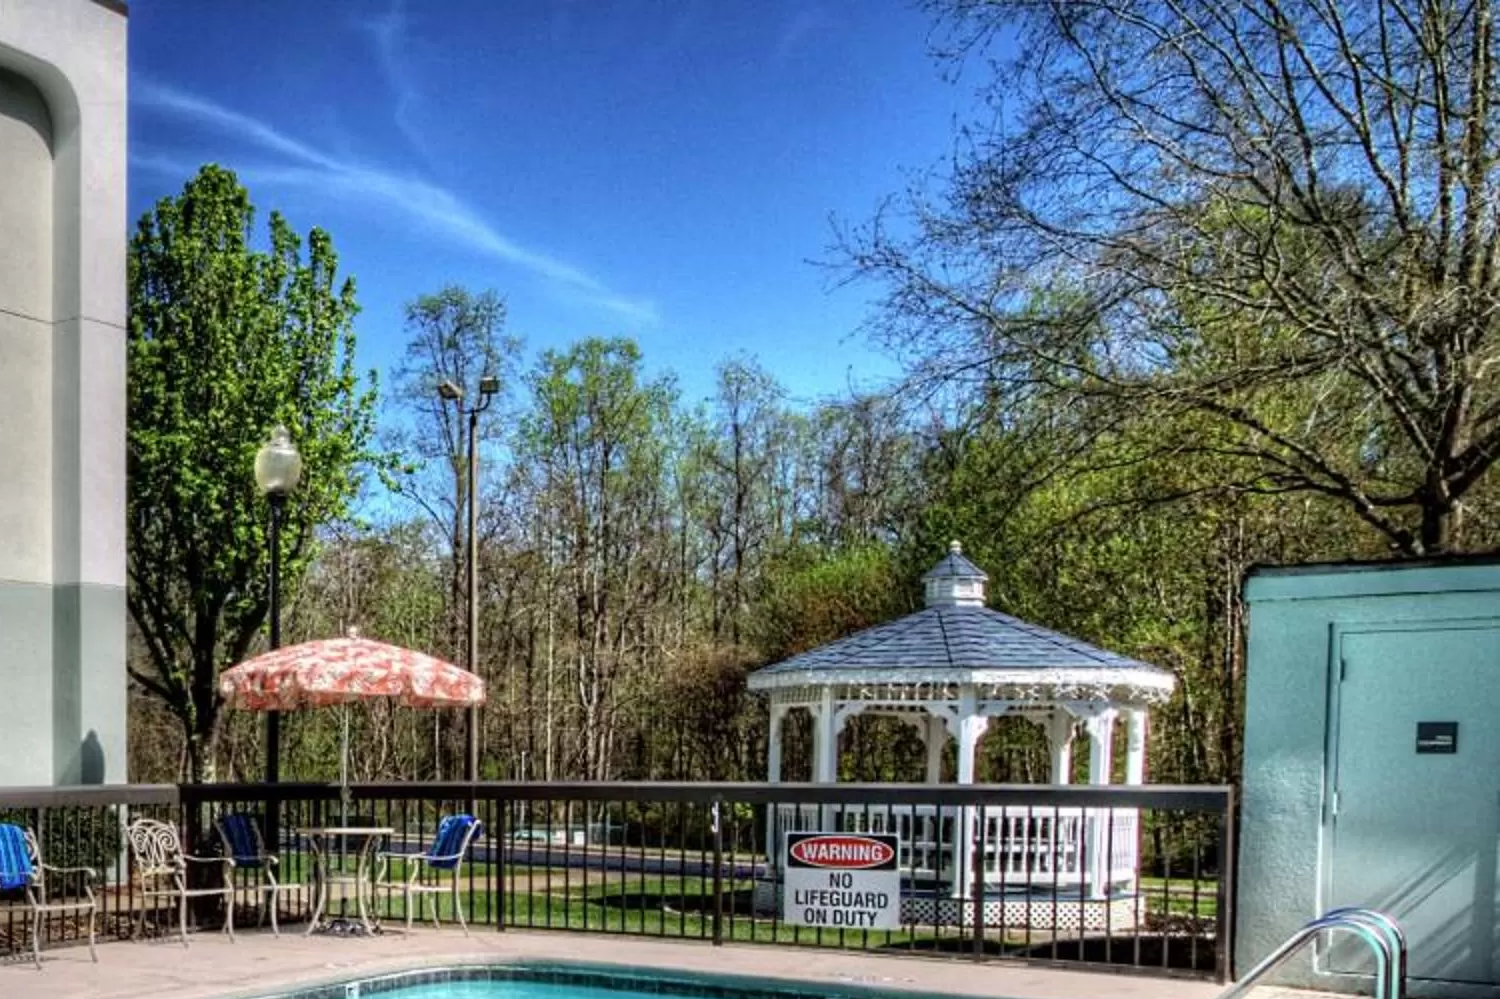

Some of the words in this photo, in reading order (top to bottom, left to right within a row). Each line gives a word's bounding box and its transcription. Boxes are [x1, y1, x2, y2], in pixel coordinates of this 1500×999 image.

[801, 843, 883, 861] WARNING
[829, 872, 853, 889] NO
[795, 890, 888, 909] LIFEGUARD
[804, 908, 827, 925] ON
[833, 910, 878, 927] DUTY
